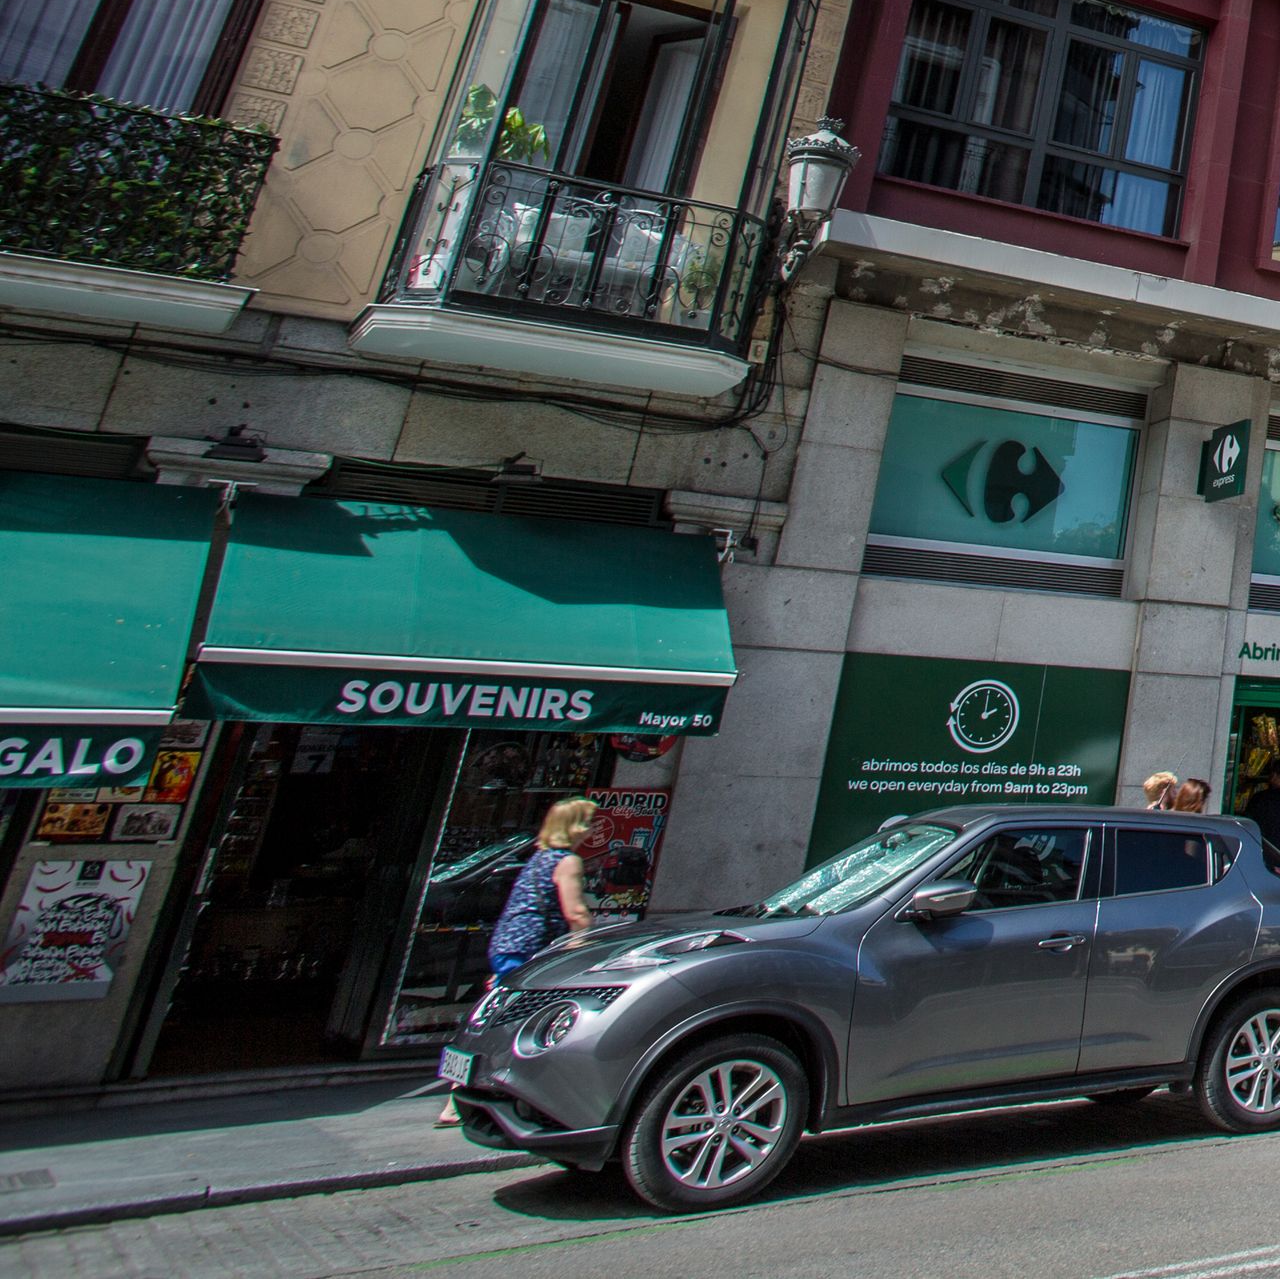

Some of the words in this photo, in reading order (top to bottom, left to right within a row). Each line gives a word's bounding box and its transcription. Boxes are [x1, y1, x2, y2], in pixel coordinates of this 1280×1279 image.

[1213, 474, 1235, 489] express
[336, 679, 594, 721] SOUVENIRS
[639, 711, 687, 729] Mayor
[692, 713, 713, 728] 50
[0, 737, 146, 776] GALO
[861, 758, 918, 772] abrimos
[920, 760, 958, 774] todos
[961, 761, 980, 774] los
[981, 761, 1008, 775] días
[1009, 763, 1026, 775] de
[1028, 764, 1045, 777] 9h
[1047, 767, 1055, 776] a
[1057, 765, 1081, 777] 23h
[848, 780, 868, 790] we
[870, 780, 905, 792] open
[907, 779, 968, 795] everyday
[970, 780, 1002, 793] from
[1004, 781, 1033, 794] 9am
[1035, 783, 1049, 794] to
[1051, 783, 1088, 796] 23pm
[589, 791, 668, 810] MADRID
